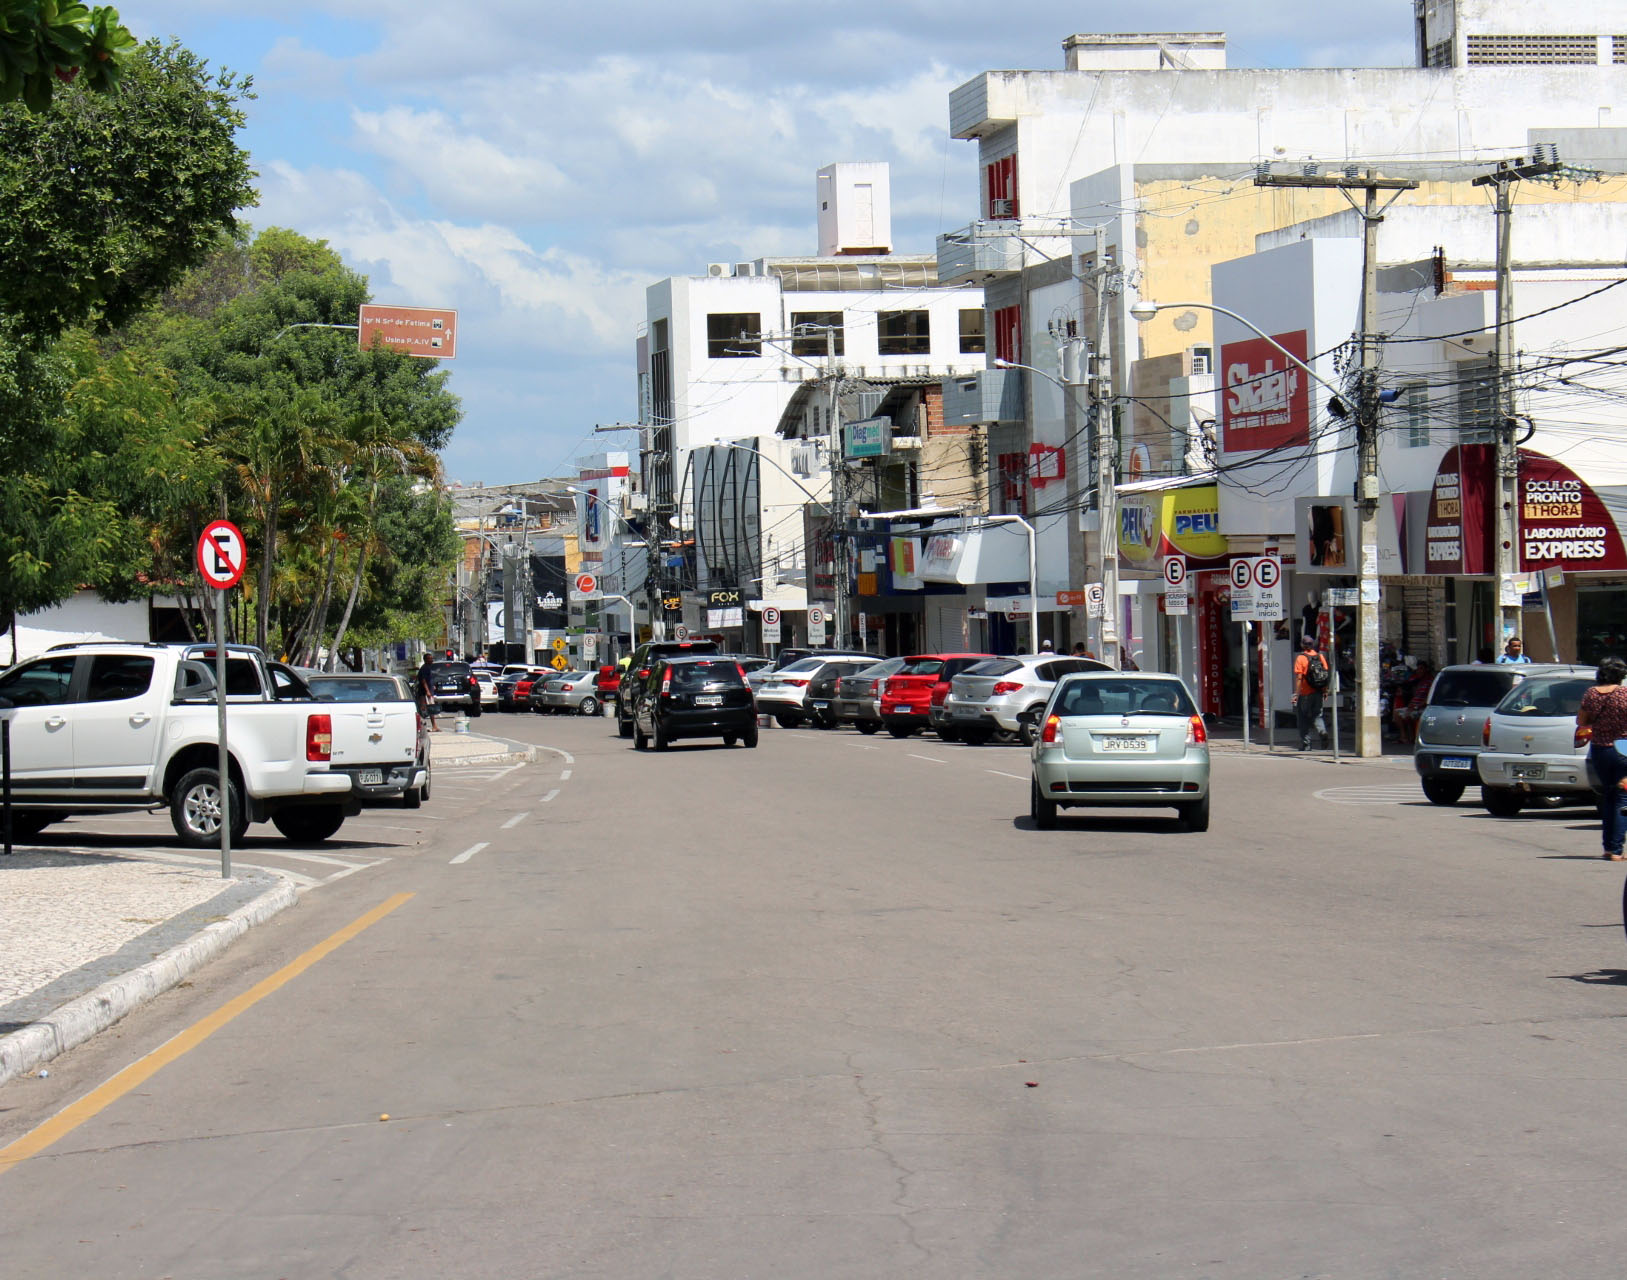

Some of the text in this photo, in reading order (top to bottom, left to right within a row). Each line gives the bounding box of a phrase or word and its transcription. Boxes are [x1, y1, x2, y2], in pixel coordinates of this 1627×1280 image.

[385, 336, 405, 344] Usina
[852, 422, 880, 443] Diagmed
[1525, 478, 1581, 492] ÓCULOS
[1525, 492, 1582, 503] PRONTO
[1444, 501, 1459, 514] HORA
[1532, 504, 1538, 516] 1
[1540, 504, 1579, 516] HORA
[1175, 513, 1218, 535] PEU
[1524, 524, 1606, 540] LABORATÓRIO
[214, 536, 231, 574] E
[1525, 540, 1606, 560] EXPRESS
[1170, 562, 1179, 580] E
[1237, 566, 1245, 584] E
[1261, 564, 1272, 583] E
[711, 591, 739, 602] FOX
[1092, 589, 1100, 599] E
[767, 610, 775, 621] E
[813, 611, 819, 621] E
